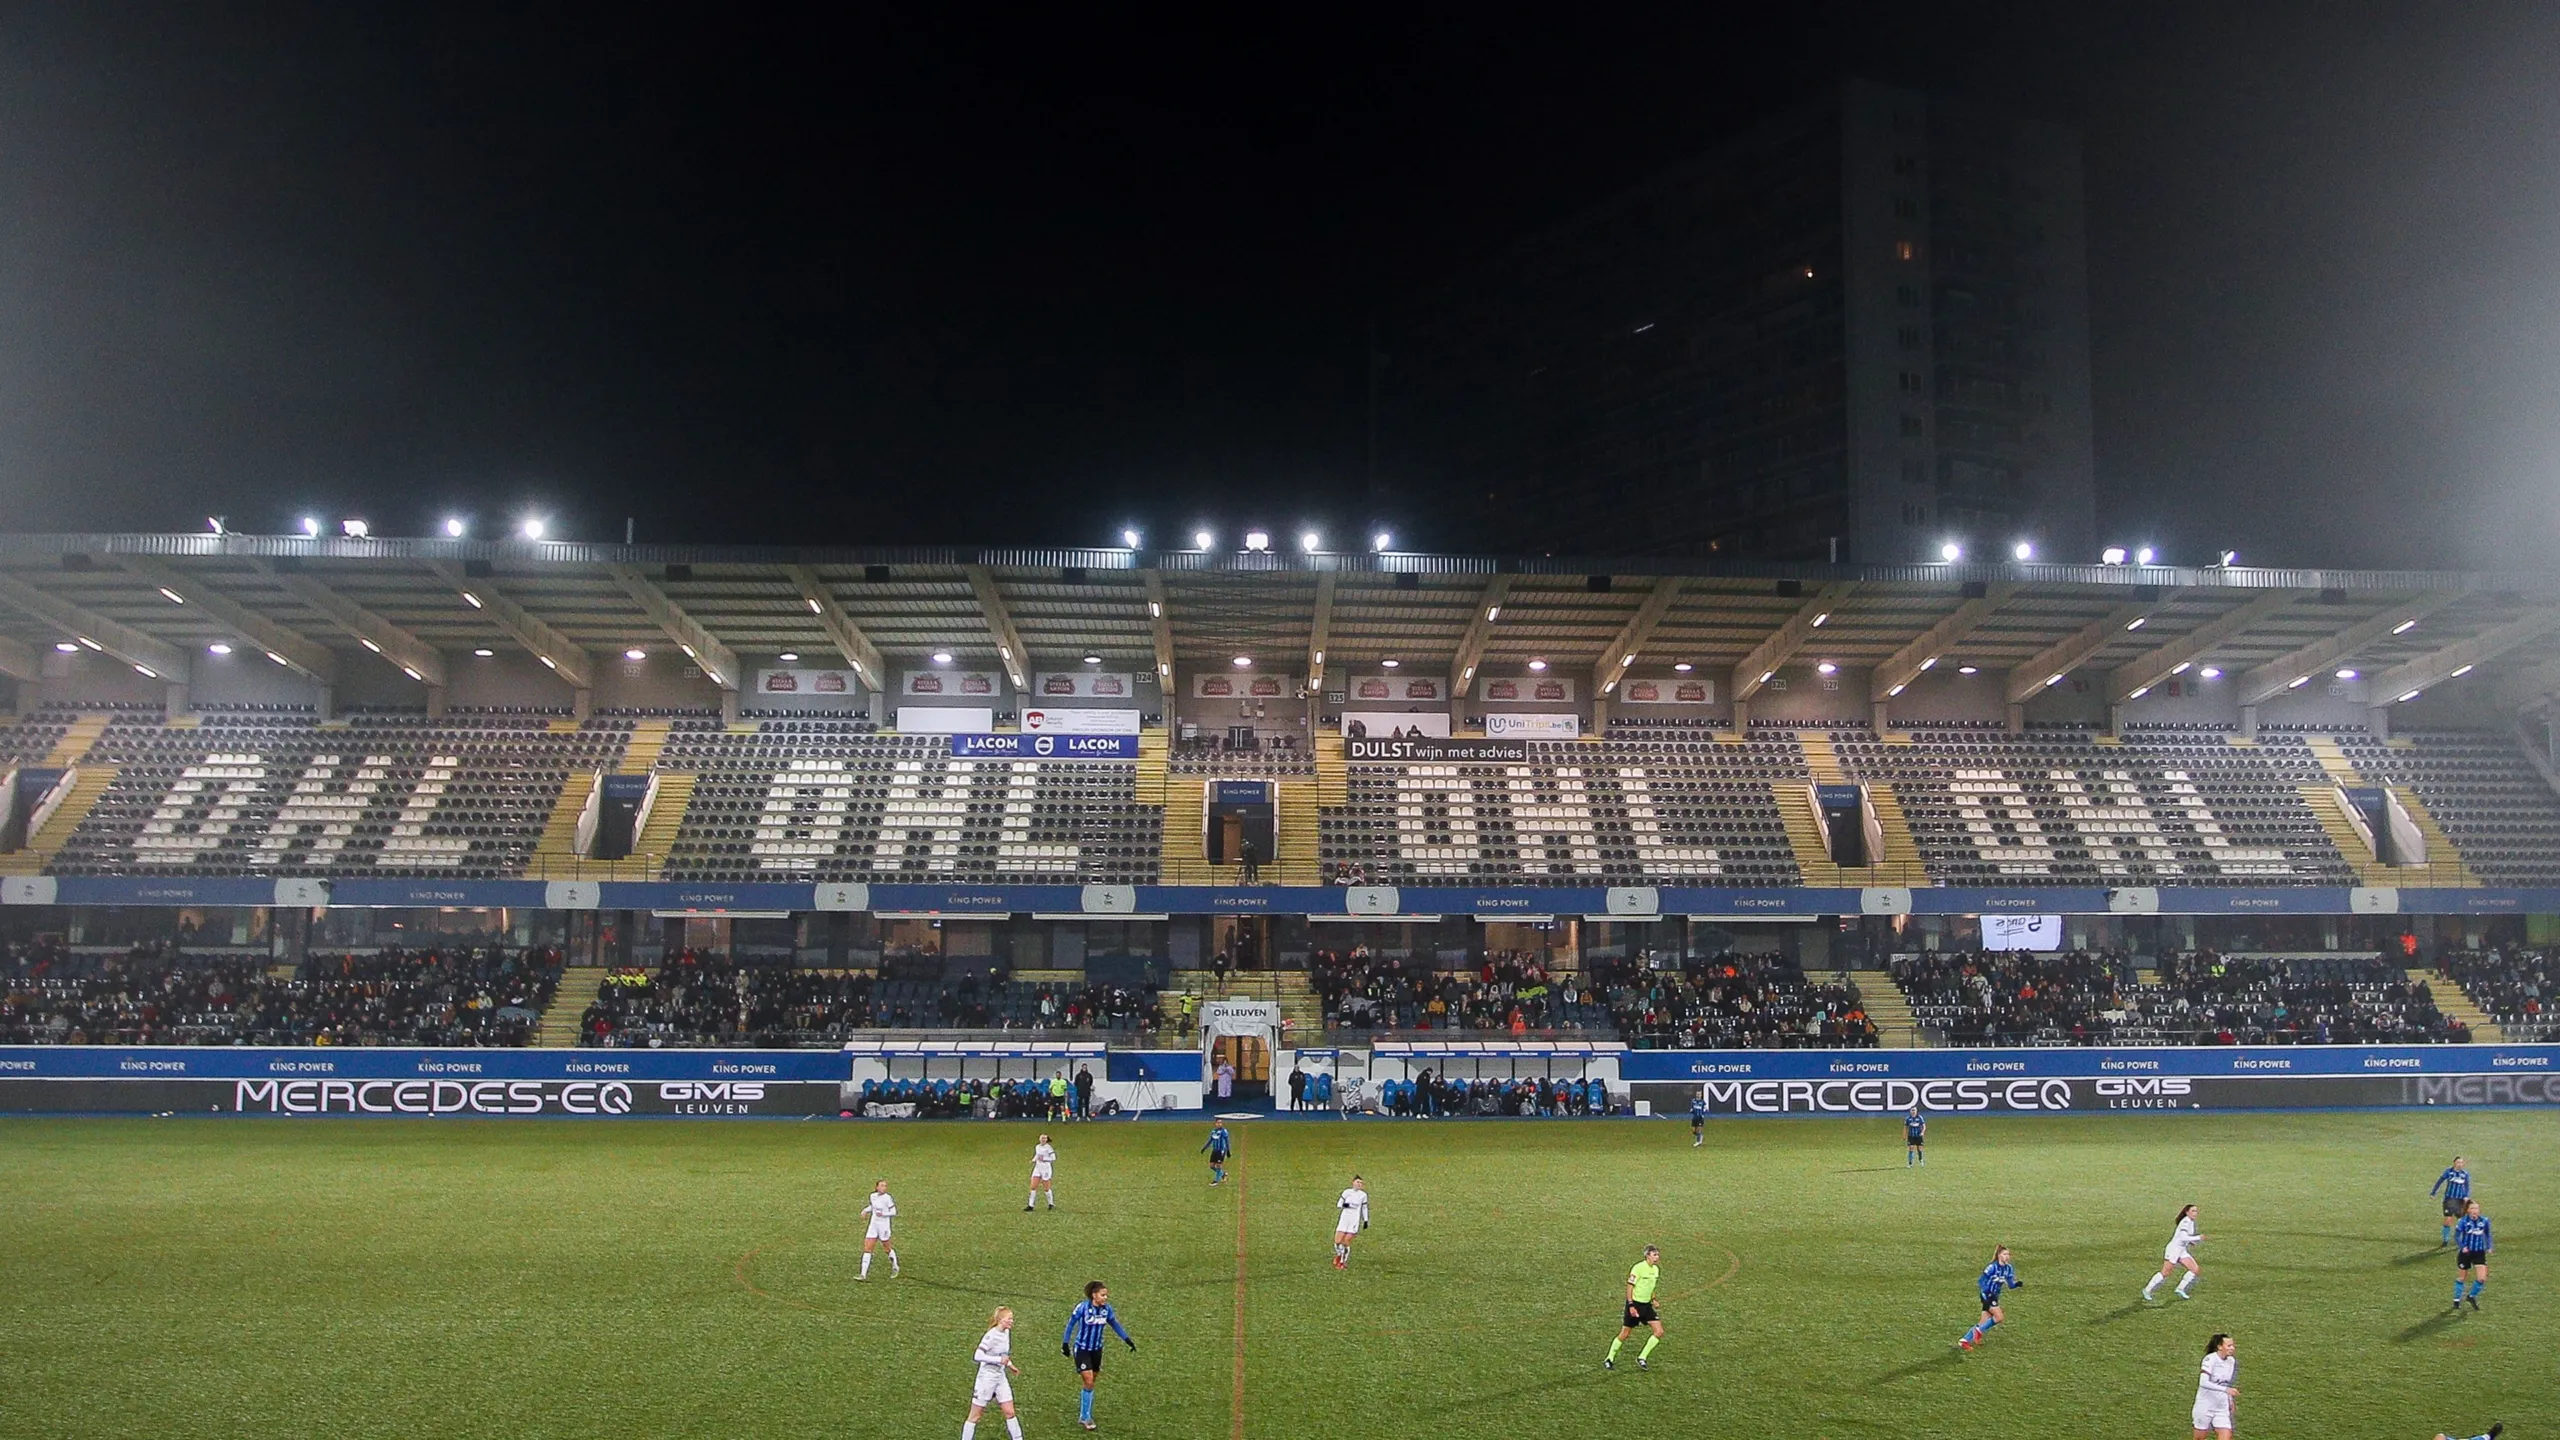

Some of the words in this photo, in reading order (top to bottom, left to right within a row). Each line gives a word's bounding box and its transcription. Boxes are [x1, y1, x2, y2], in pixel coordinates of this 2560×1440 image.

[967, 738, 1018, 749] LACOM
[1069, 738, 1120, 750] LACOM
[1352, 742, 1414, 758] DULST
[1416, 746, 1443, 760] wijn
[1448, 746, 1474, 758] met
[1478, 746, 1523, 758] advies
[1214, 898, 1236, 906] KING
[1238, 898, 1268, 906] POWER
[1213, 1008, 1229, 1016] OH
[1231, 1008, 1267, 1016] LEUVEN
[0, 1061, 36, 1070] POWER
[120, 1062, 148, 1070] KING
[150, 1062, 186, 1071] POWER
[1966, 1062, 1990, 1071] KING
[1992, 1062, 2025, 1071] POWER
[2100, 1062, 2126, 1070] KING
[2127, 1062, 2160, 1070] POWER
[2233, 1060, 2258, 1069] KING
[2258, 1060, 2290, 1069] POWER
[2364, 1059, 2388, 1068] KING
[2389, 1059, 2421, 1068] POWER
[2492, 1058, 2516, 1066] KING
[2517, 1058, 2549, 1066] POWER
[270, 1062, 296, 1071] KING
[298, 1062, 334, 1072] POWER
[418, 1064, 444, 1072] KING
[446, 1064, 482, 1072] POWER
[566, 1064, 592, 1072] KING
[594, 1064, 630, 1073] POWER
[712, 1065, 739, 1074] KING
[740, 1065, 776, 1074] POWER
[1691, 1064, 1716, 1073] KING
[1718, 1064, 1752, 1073] POWER
[1830, 1064, 1854, 1072] KING
[1856, 1064, 1890, 1072] POWER
[2096, 1078, 2192, 1095] GMS
[660, 1083, 765, 1100] GMS
[1703, 1079, 2071, 1112] MERCEDES-EQ
[235, 1079, 633, 1114] MERCEDES-EQ
[675, 1104, 749, 1114] LEUVEN
[2110, 1100, 2177, 1109] LEUVEN
